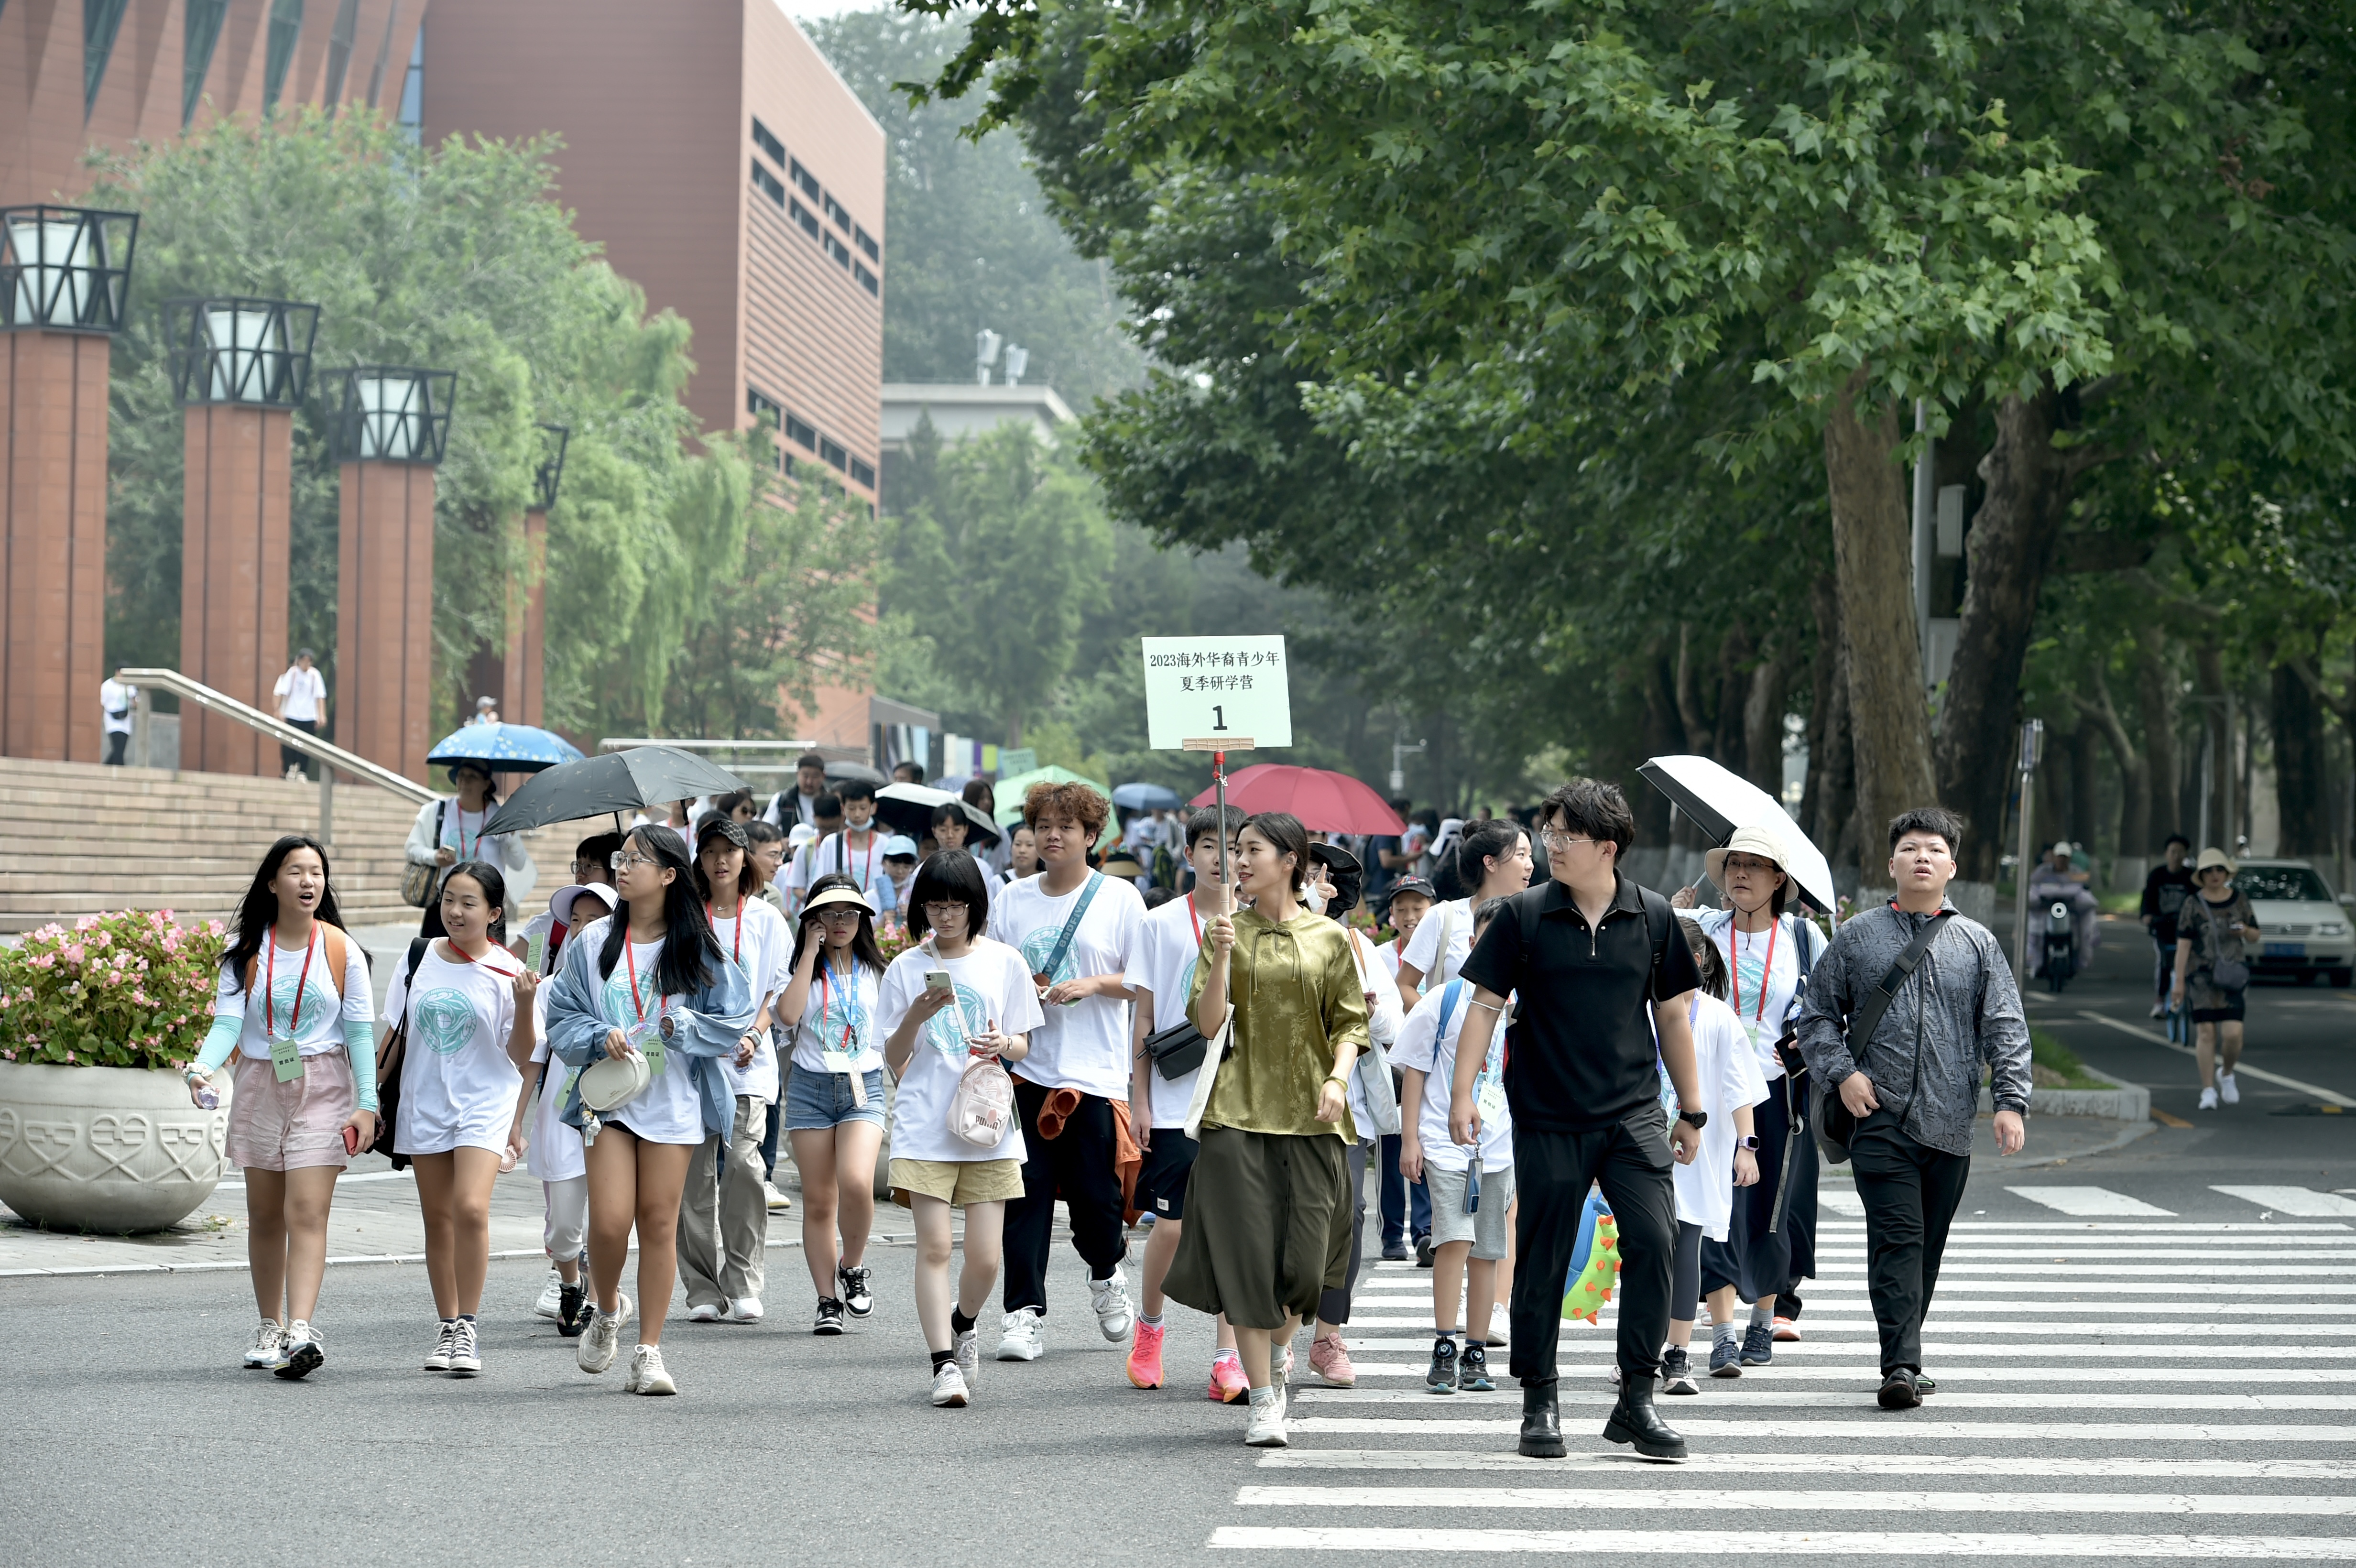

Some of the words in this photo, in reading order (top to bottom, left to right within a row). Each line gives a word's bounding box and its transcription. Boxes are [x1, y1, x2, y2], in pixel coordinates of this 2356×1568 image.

[1150, 651, 1279, 667] 2023海外华裔青少年
[1180, 675, 1253, 692] 夏季研学营
[1212, 705, 1228, 730] 1
[1058, 899, 1088, 948] BADFIVE
